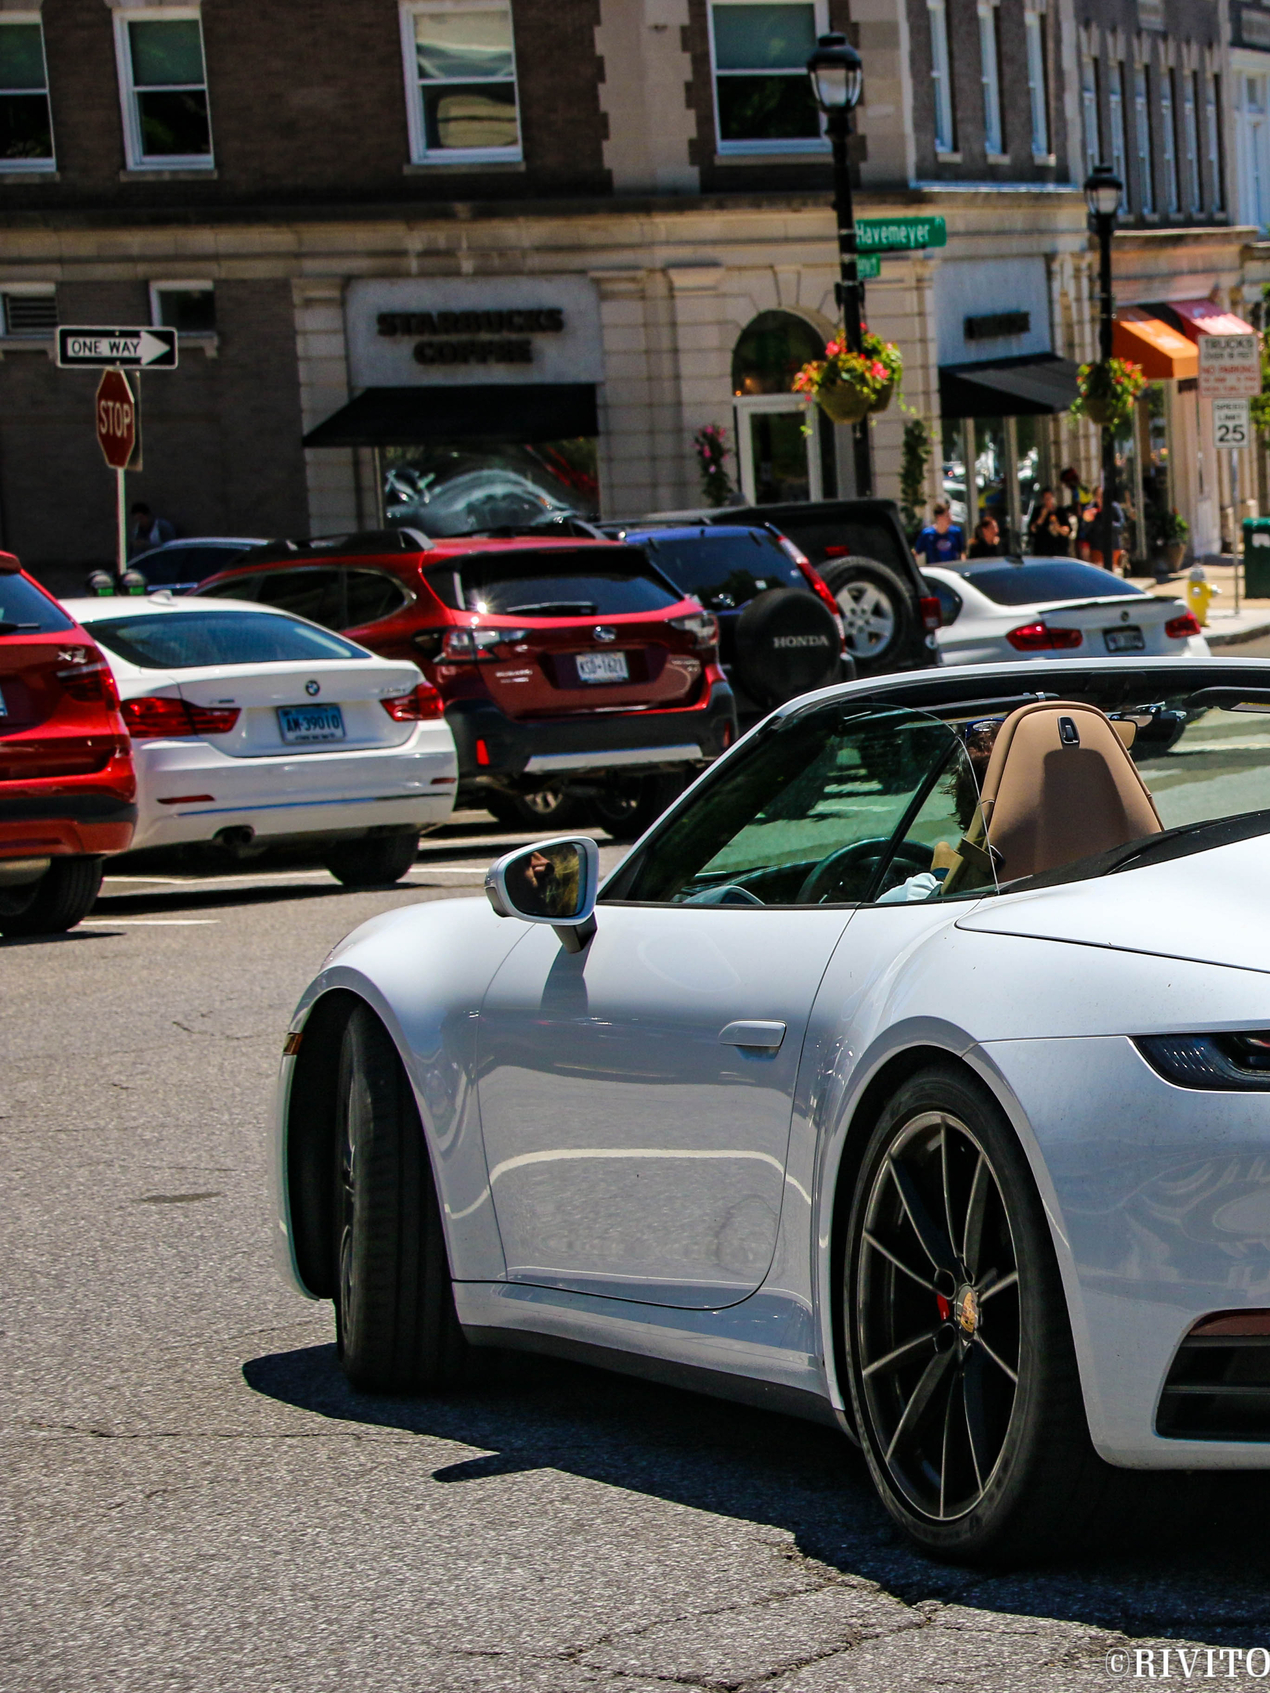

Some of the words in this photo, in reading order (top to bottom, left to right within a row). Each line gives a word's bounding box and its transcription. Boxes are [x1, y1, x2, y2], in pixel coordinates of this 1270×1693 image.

[856, 222, 930, 248] Havemeyer
[377, 308, 564, 336] STARBUCKS
[71, 340, 101, 354] ONE
[109, 340, 140, 354] WAY
[413, 339, 534, 365] COFFEE
[1205, 338, 1253, 349] TRUCKS
[100, 400, 131, 438] STOP
[1218, 424, 1245, 442] 25
[773, 635, 829, 648] HONDA
